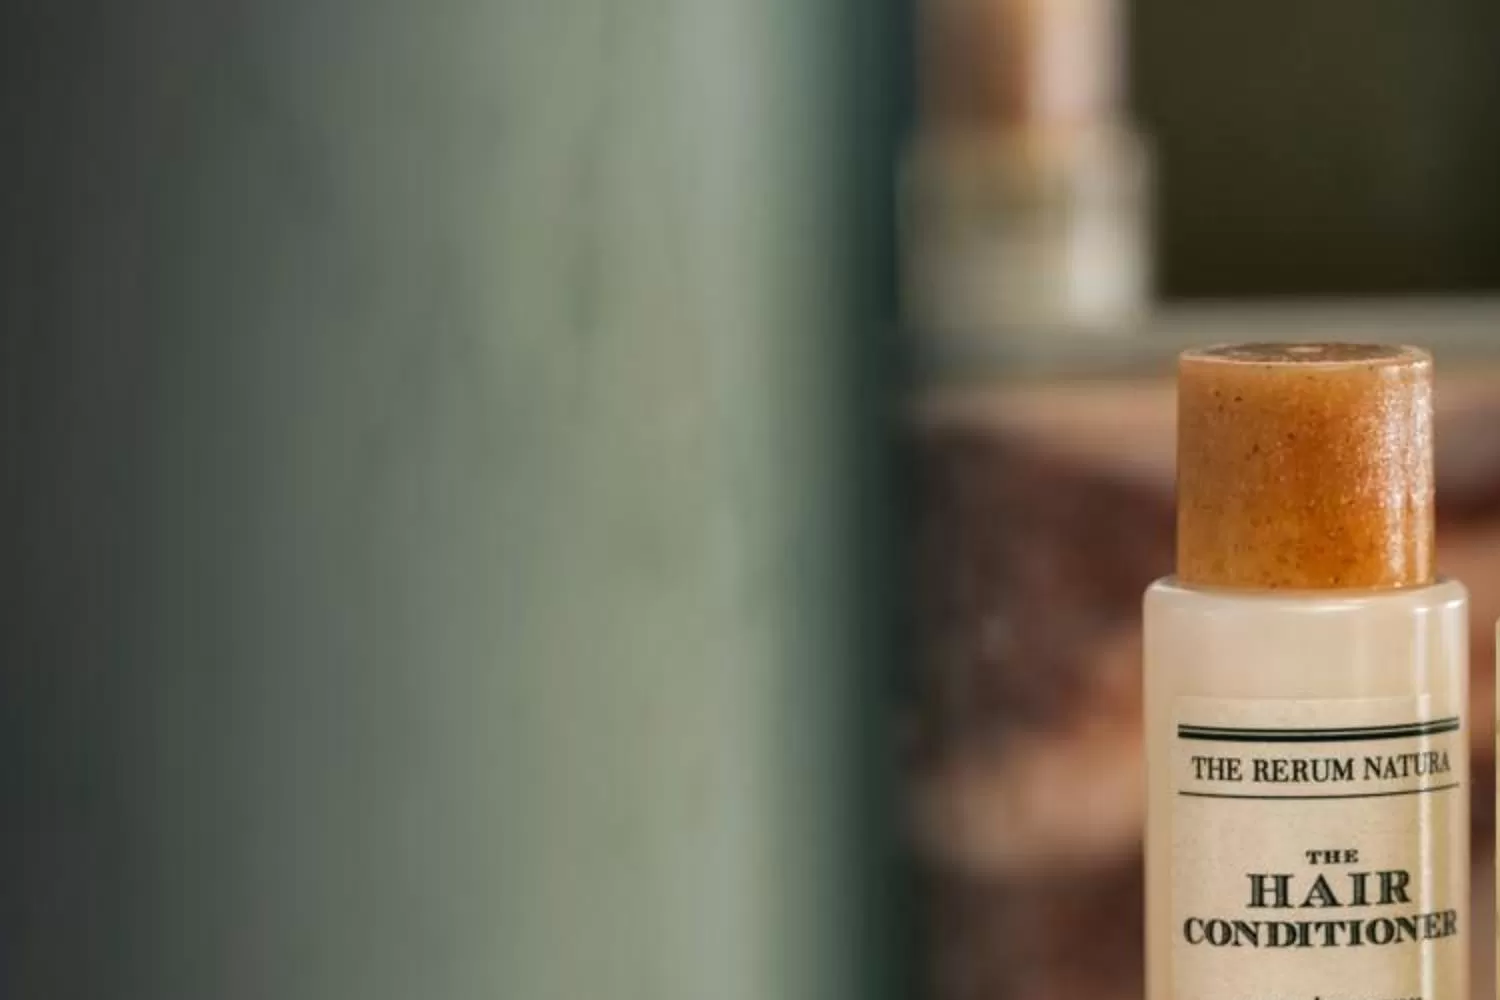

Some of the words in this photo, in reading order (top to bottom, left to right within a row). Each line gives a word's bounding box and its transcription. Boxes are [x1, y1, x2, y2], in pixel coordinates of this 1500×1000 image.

[1191, 756, 1243, 782] THE
[1252, 757, 1354, 783] RERUM
[1363, 751, 1451, 780] NATURA
[1306, 849, 1359, 865] THE
[1246, 870, 1412, 908] HAIR
[1183, 910, 1457, 947] CONDITIONER
